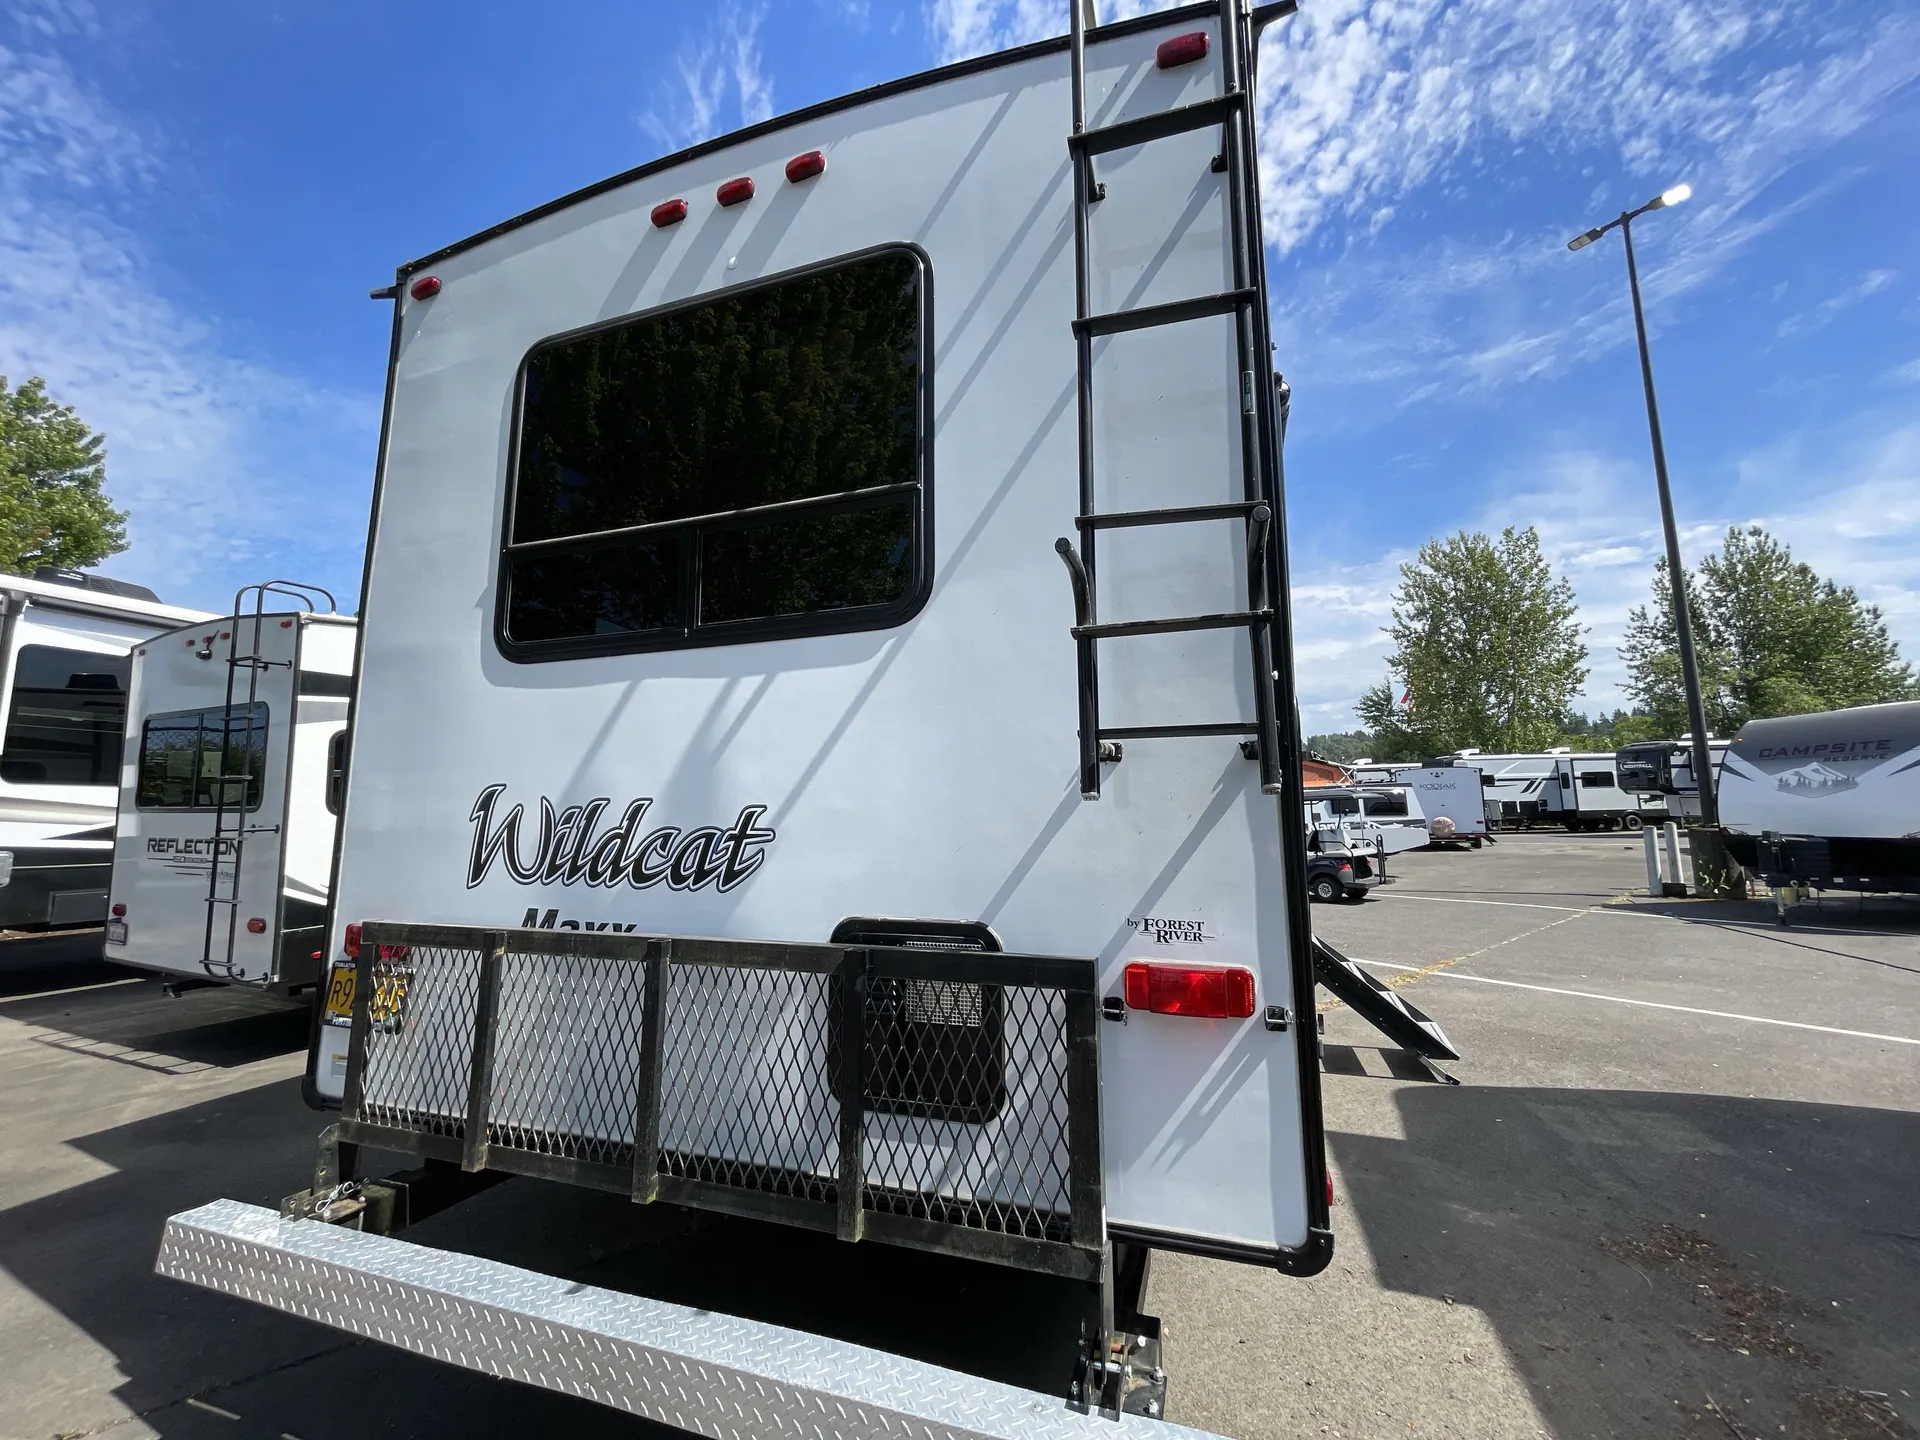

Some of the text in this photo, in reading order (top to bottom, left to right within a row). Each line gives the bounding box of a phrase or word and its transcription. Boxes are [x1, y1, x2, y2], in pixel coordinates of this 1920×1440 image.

[1758, 739, 1894, 759] CAMPSITE
[1822, 753, 1888, 762] RESERVE
[466, 783, 776, 893] Wildcat
[147, 837, 239, 856] REFLECTON
[1127, 918, 1205, 932] by FOREST
[1156, 929, 1204, 943] RIVER
